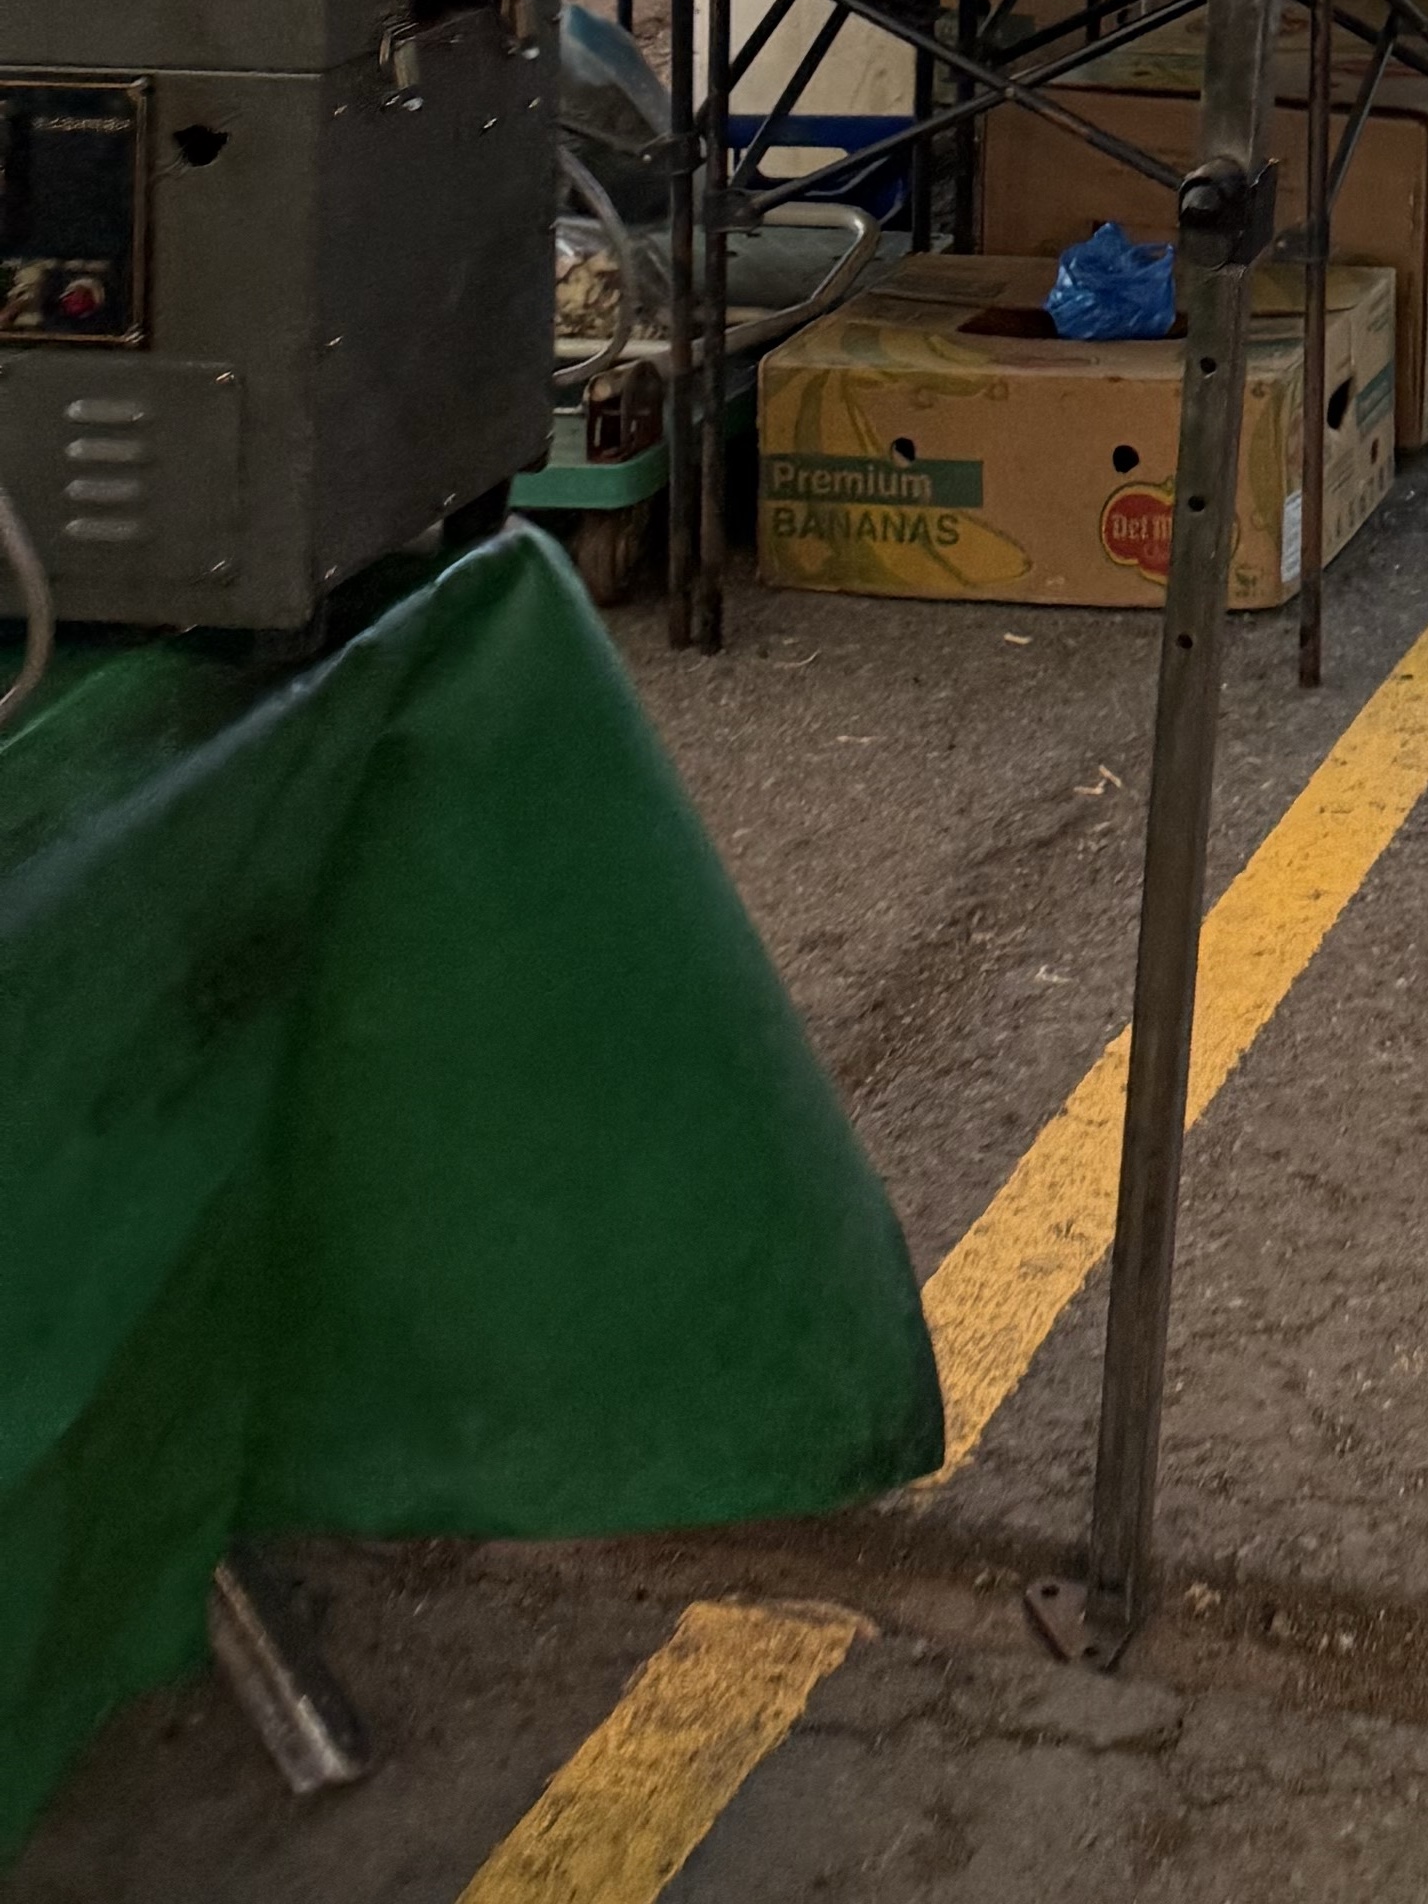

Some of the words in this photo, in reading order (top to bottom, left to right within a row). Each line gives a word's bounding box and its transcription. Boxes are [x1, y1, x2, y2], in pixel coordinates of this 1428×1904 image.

[772, 460, 933, 503] Premium
[771, 506, 961, 546] BANANAS
[1110, 513, 1149, 540] Del
